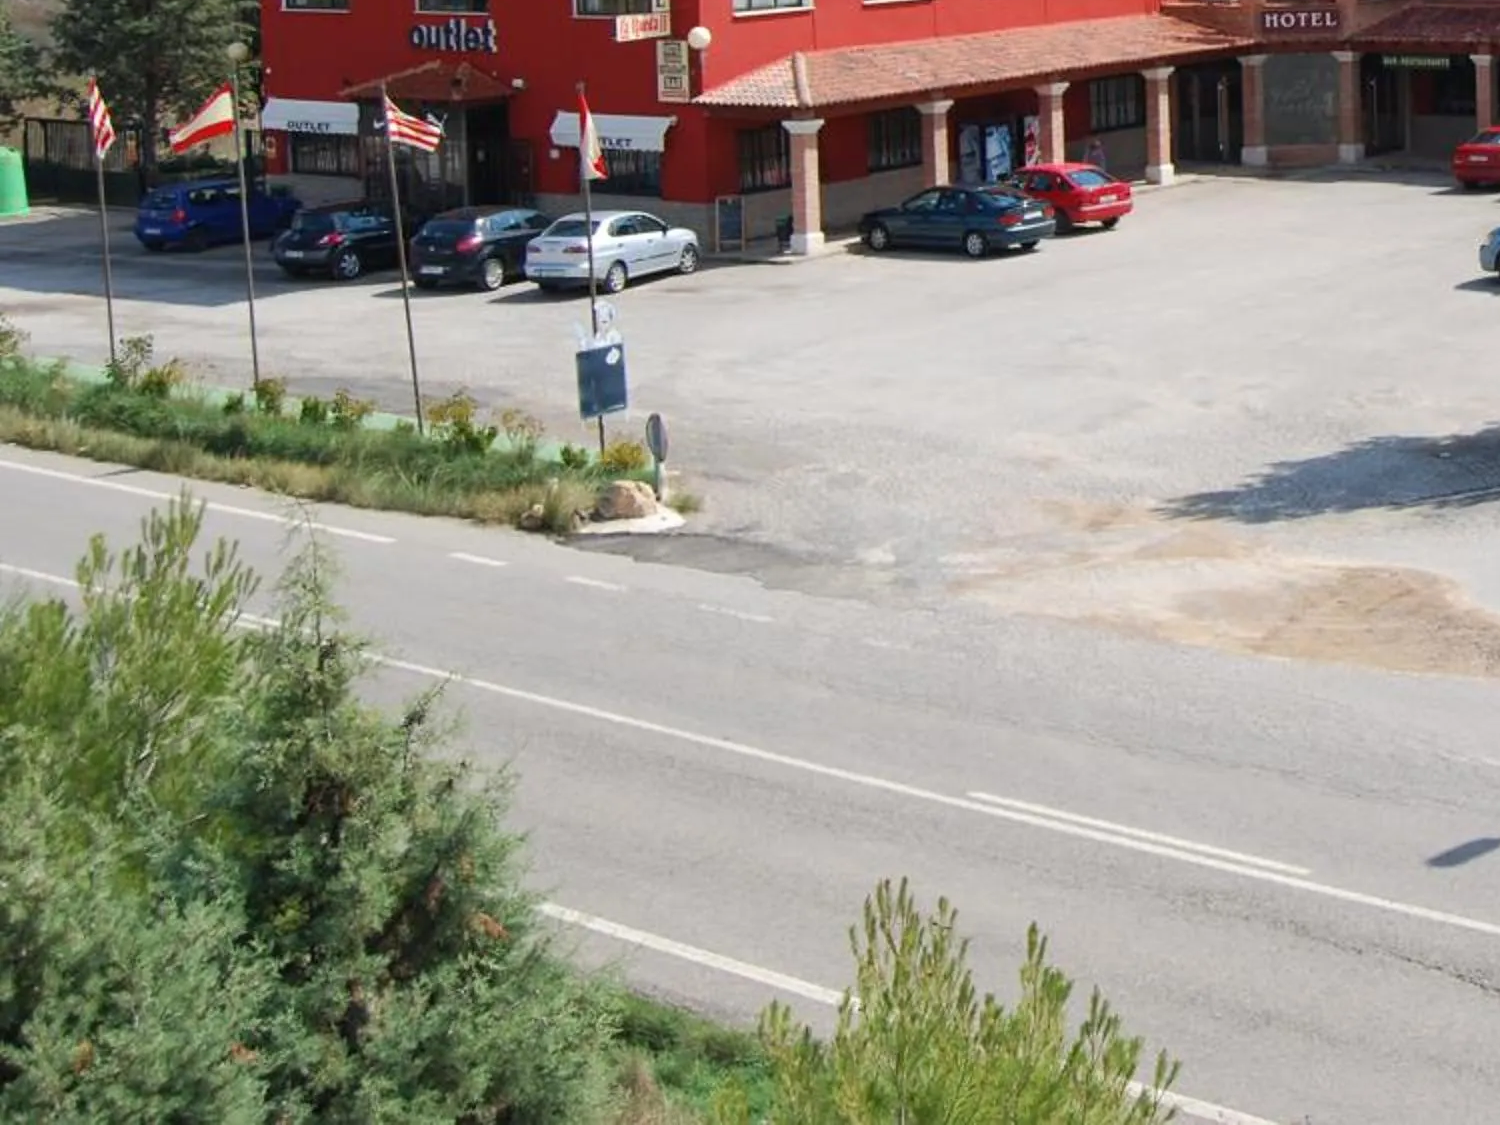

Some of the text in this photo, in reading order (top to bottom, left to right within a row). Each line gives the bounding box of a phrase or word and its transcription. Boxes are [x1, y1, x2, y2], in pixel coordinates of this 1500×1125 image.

[1264, 12, 1337, 28] HOTEL
[410, 18, 498, 53] outlet
[286, 120, 331, 131] OUTLET
